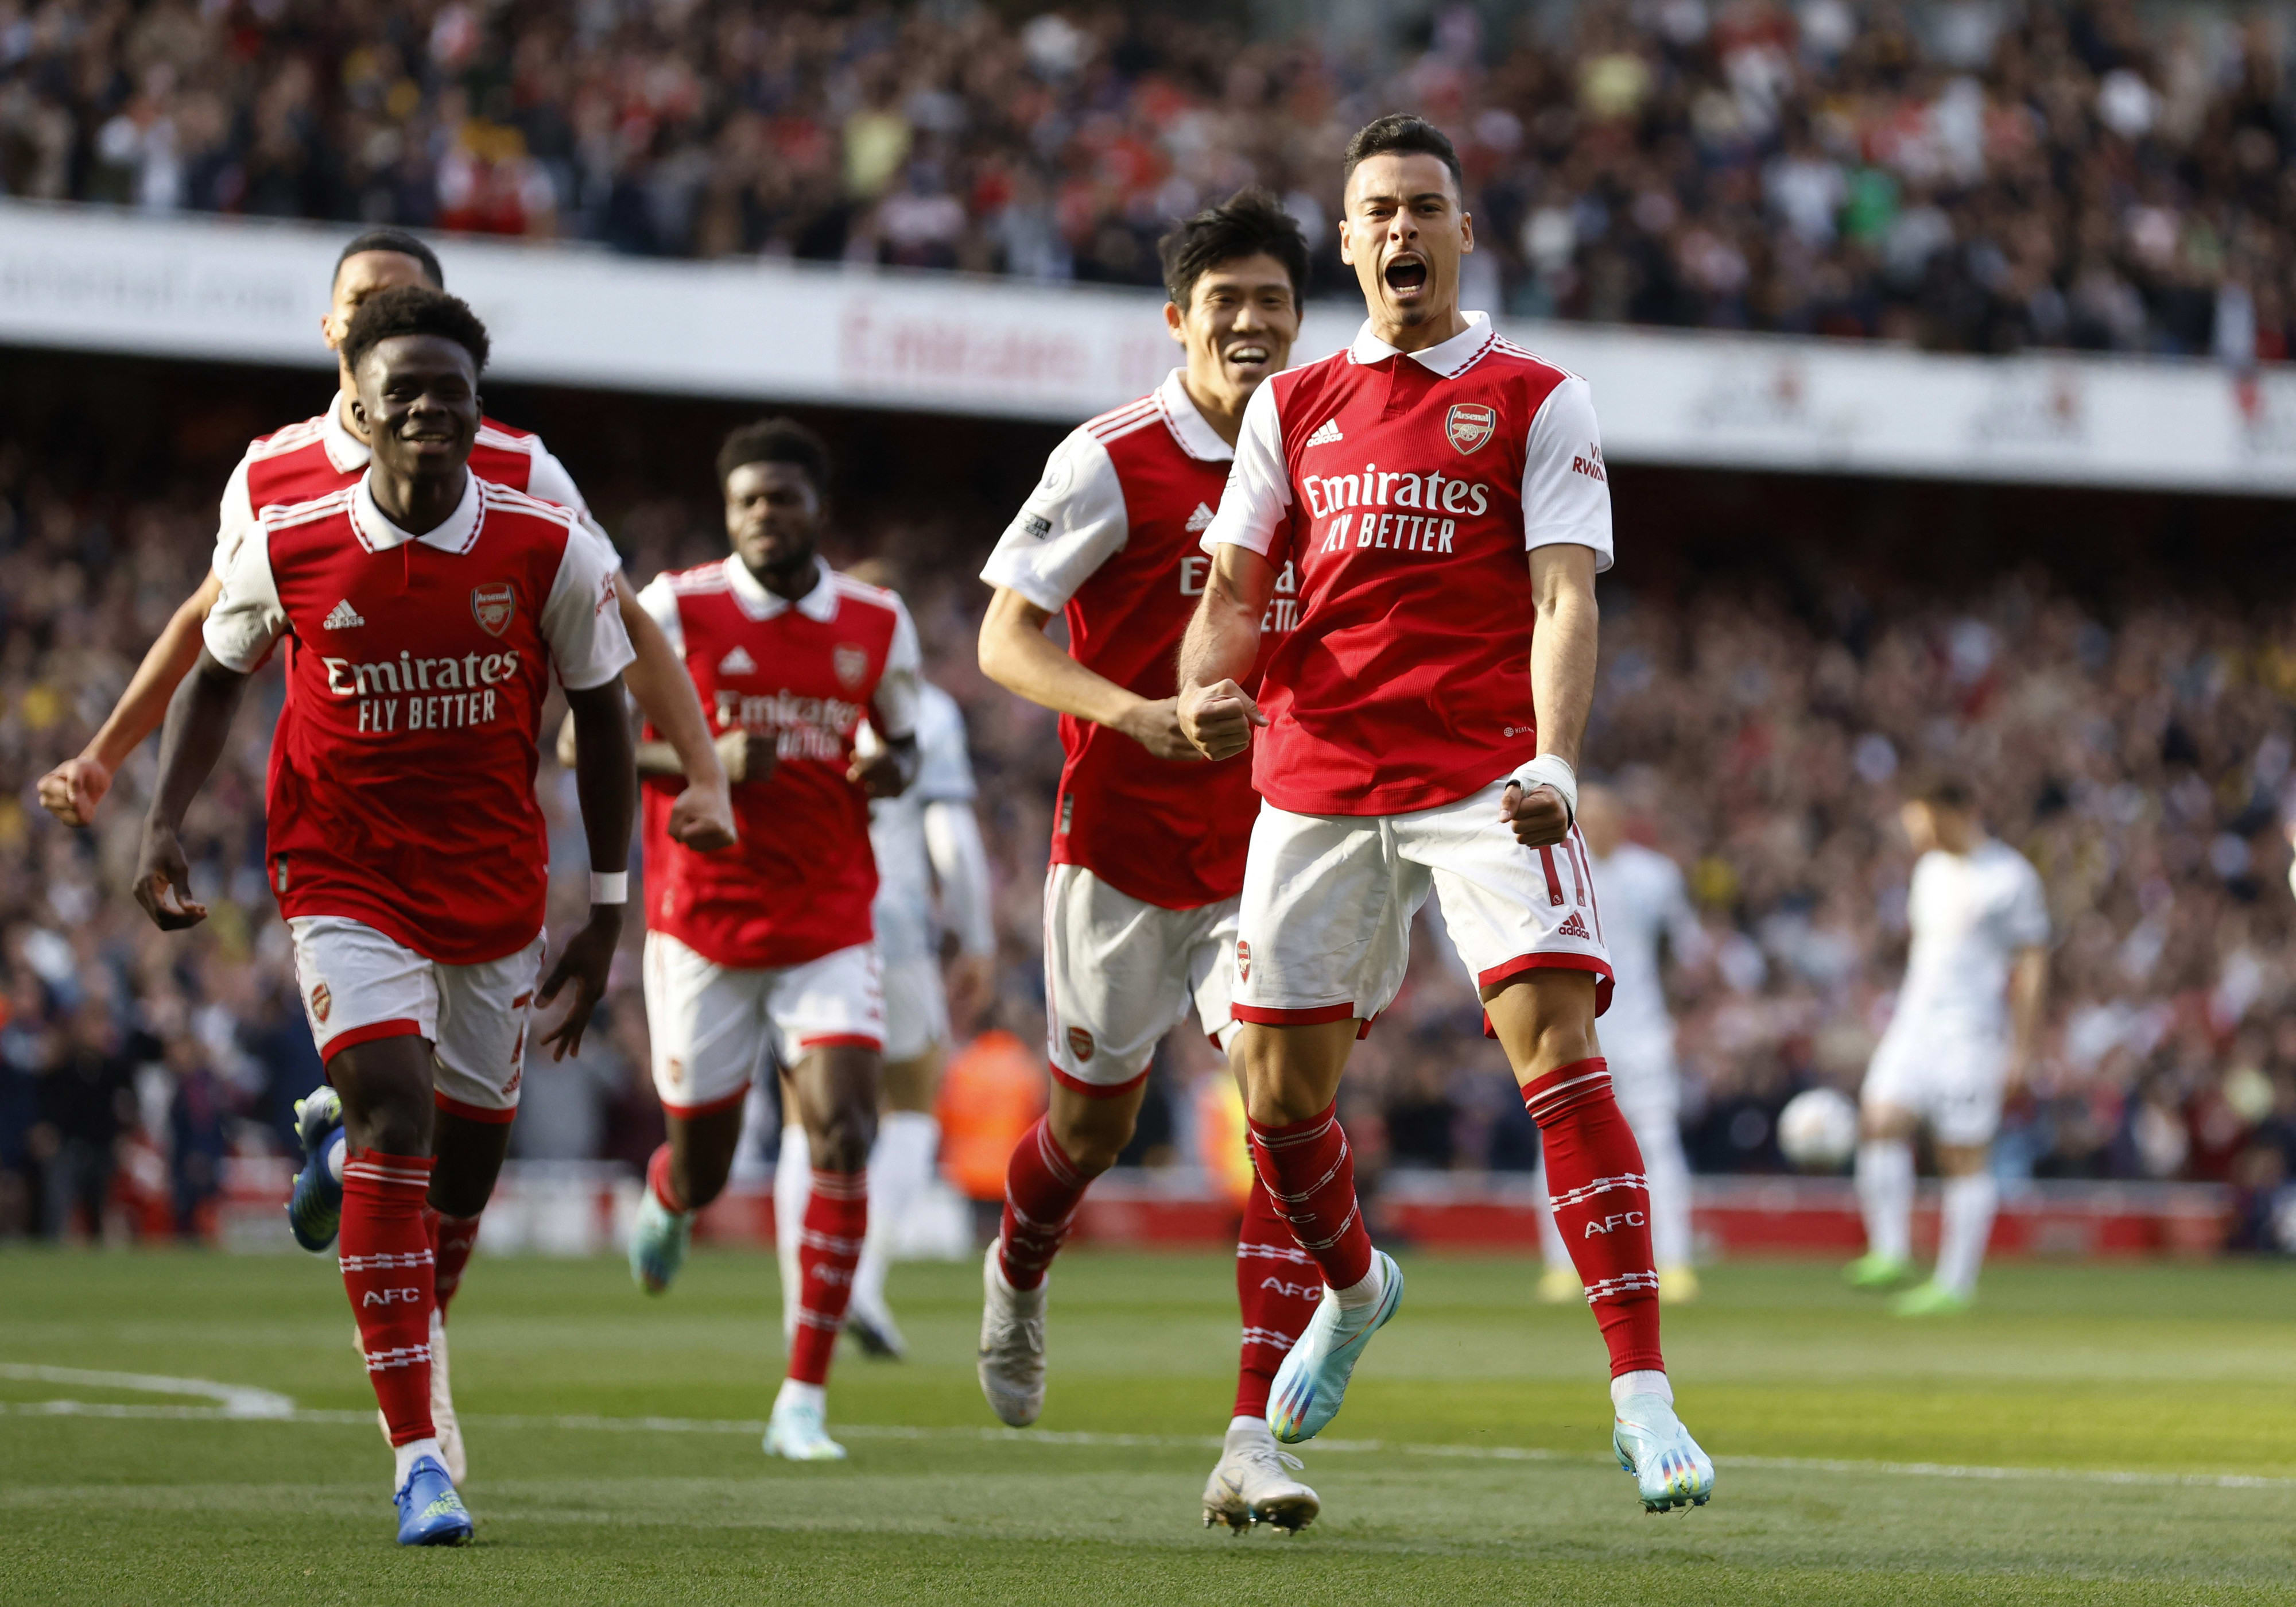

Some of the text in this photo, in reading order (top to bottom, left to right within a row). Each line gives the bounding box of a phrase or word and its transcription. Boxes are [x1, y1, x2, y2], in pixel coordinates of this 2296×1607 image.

[1454, 410, 1489, 422] Arsenal
[1306, 432, 1344, 448] adidas
[1302, 463, 1489, 519] Emirates
[1356, 513, 1455, 554] BETTER
[323, 616, 366, 630] adidas
[321, 650, 519, 695] Emirates
[358, 688, 496, 733] FLY BETTER
[1530, 838, 1587, 907] 11
[1558, 926, 1590, 940] adidas
[1584, 1211, 1645, 1239] AFC
[362, 1287, 420, 1308] AFC
[1261, 1276, 1322, 1301] AFC
